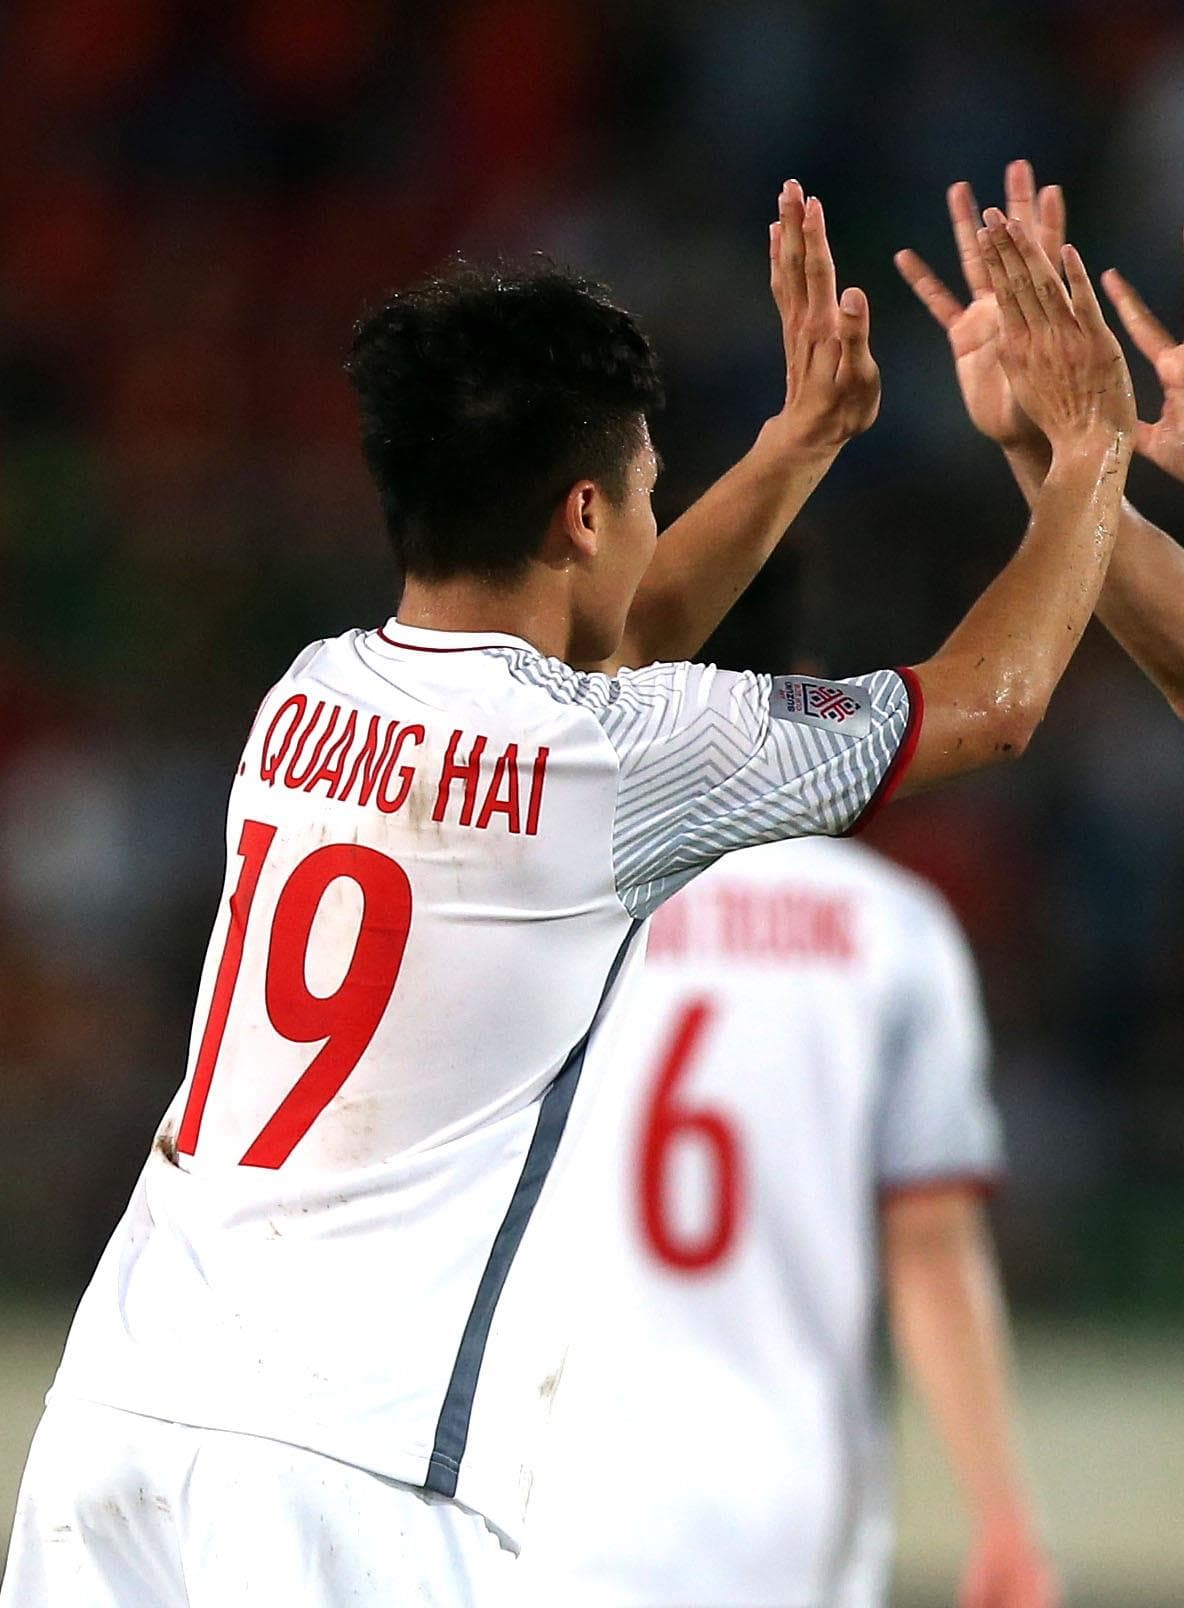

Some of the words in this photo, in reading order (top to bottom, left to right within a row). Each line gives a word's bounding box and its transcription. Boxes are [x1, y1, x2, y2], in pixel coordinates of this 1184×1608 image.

[260, 693, 426, 814] QUANG
[431, 729, 550, 836] HAI
[175, 819, 413, 1170] 19
[633, 994, 746, 1276] 6
